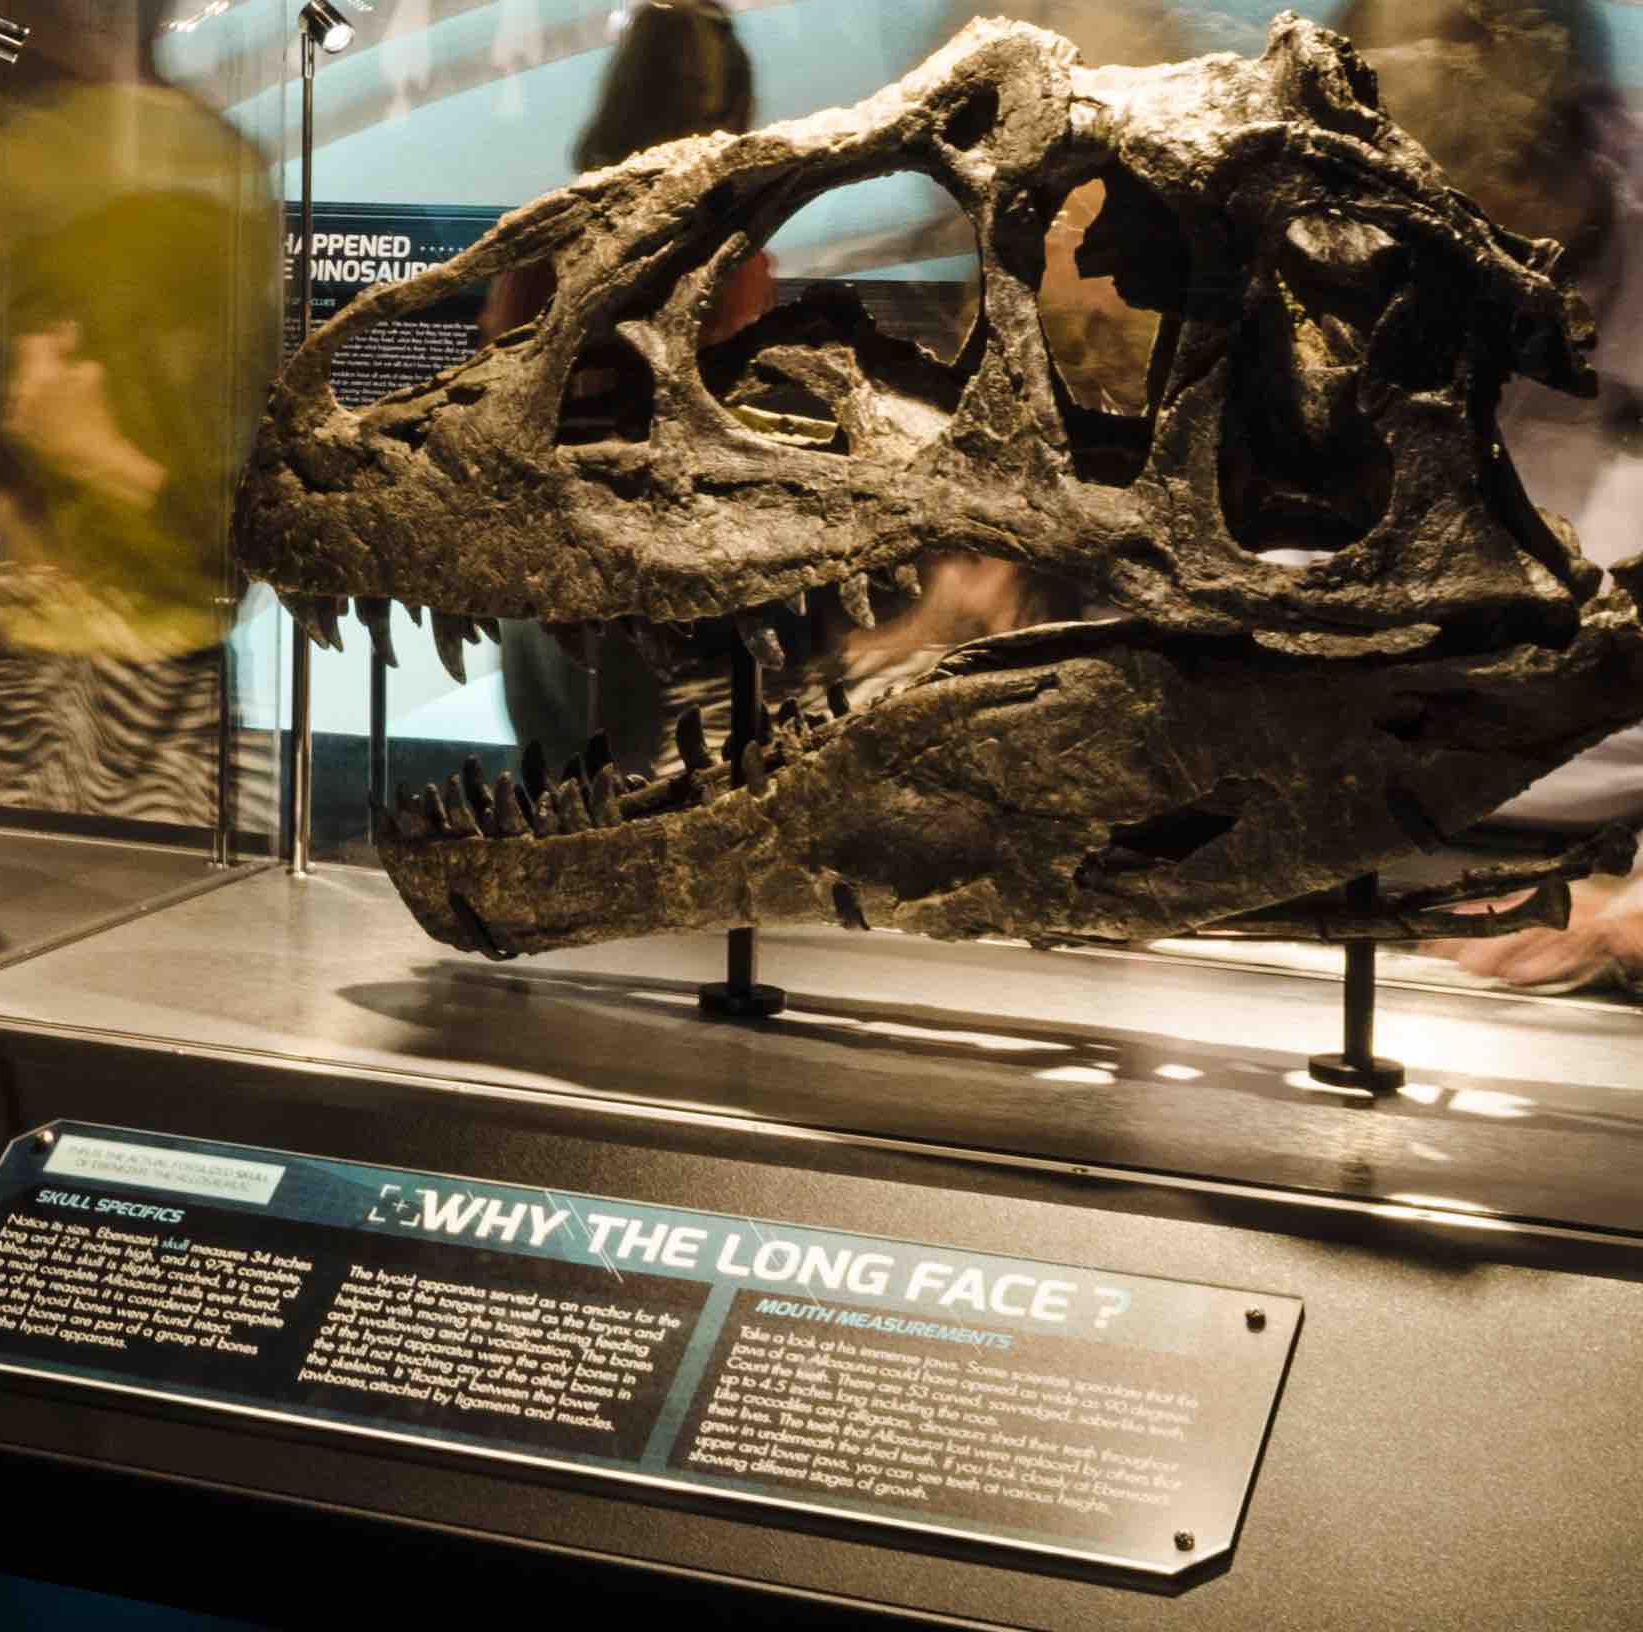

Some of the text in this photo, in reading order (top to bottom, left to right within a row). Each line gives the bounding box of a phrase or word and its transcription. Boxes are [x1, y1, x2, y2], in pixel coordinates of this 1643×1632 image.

[35, 1189, 186, 1224] SKULL SPECIFICS
[0, 1226, 28, 1244] long
[30, 1233, 59, 1245] and
[59, 1235, 80, 1249] 22
[81, 1241, 121, 1256] inches
[160, 1254, 189, 1266] and
[189, 1258, 200, 1268] is
[204, 1258, 236, 1274] 97%
[7, 1213, 49, 1230] Notice
[161, 1236, 190, 1250] skull
[189, 1244, 248, 1261] measures
[250, 1250, 271, 1264] 34
[271, 1255, 312, 1271] inches
[418, 1188, 1131, 1330] WHY THE LONG FACE ?
[9, 1272, 26, 1284] of
[25, 1274, 46, 1289] the
[48, 1281, 98, 1297] reasons
[127, 1294, 202, 1314] considered
[202, 1307, 220, 1317] so
[222, 1310, 284, 1328] complete
[39, 1265, 98, 1282] complete
[100, 1272, 168, 1293] Allosaurus
[169, 1283, 203, 1299] skulls
[206, 1292, 237, 1304] ever
[50, 1248, 72, 1263] this
[74, 1253, 106, 1267] skull
[106, 1259, 117, 1270] is
[119, 1259, 165, 1279] slightly
[252, 1284, 280, 1296] one
[282, 1286, 300, 1298] of
[349, 1264, 681, 1328] The hyoid apparatus served as an anchor for the
[9, 1287, 30, 1301] the
[33, 1290, 72, 1308] hyoid
[72, 1296, 112, 1314] bones
[116, 1308, 149, 1321] were
[151, 1309, 193, 1328] found
[19, 1318, 58, 1336] hyoid
[26, 1304, 66, 1322] bones
[69, 1315, 93, 1327] are
[93, 1319, 124, 1331] part
[125, 1322, 142, 1334] of
[142, 1327, 153, 1337] a
[154, 1330, 197, 1346] group
[199, 1334, 217, 1346] of
[216, 1335, 258, 1353] bones
[333, 1292, 650, 1358] helped with moving the tongue during feeding
[340, 1282, 666, 1341] muscles of the tongue as well as the larynx and
[755, 1298, 1015, 1350] MOUTH MEASUREMENTS
[320, 1322, 636, 1385] of the hyoid apparatus were the only bones in
[327, 1308, 357, 1323] and
[357, 1316, 436, 1339] swallowing
[438, 1328, 469, 1342] and
[469, 1332, 484, 1344] in
[581, 1346, 606, 1364] The
[609, 1351, 653, 1372] bones
[306, 1350, 328, 1366] the
[393, 1365, 404, 1378] It
[468, 1376, 529, 1400] between
[532, 1388, 556, 1404] the
[558, 1391, 600, 1411] lower
[312, 1336, 632, 1401] the skull not touching any of the other bones in
[432, 1387, 452, 1406] by
[454, 1391, 521, 1415] ligaments
[523, 1406, 556, 1420] and
